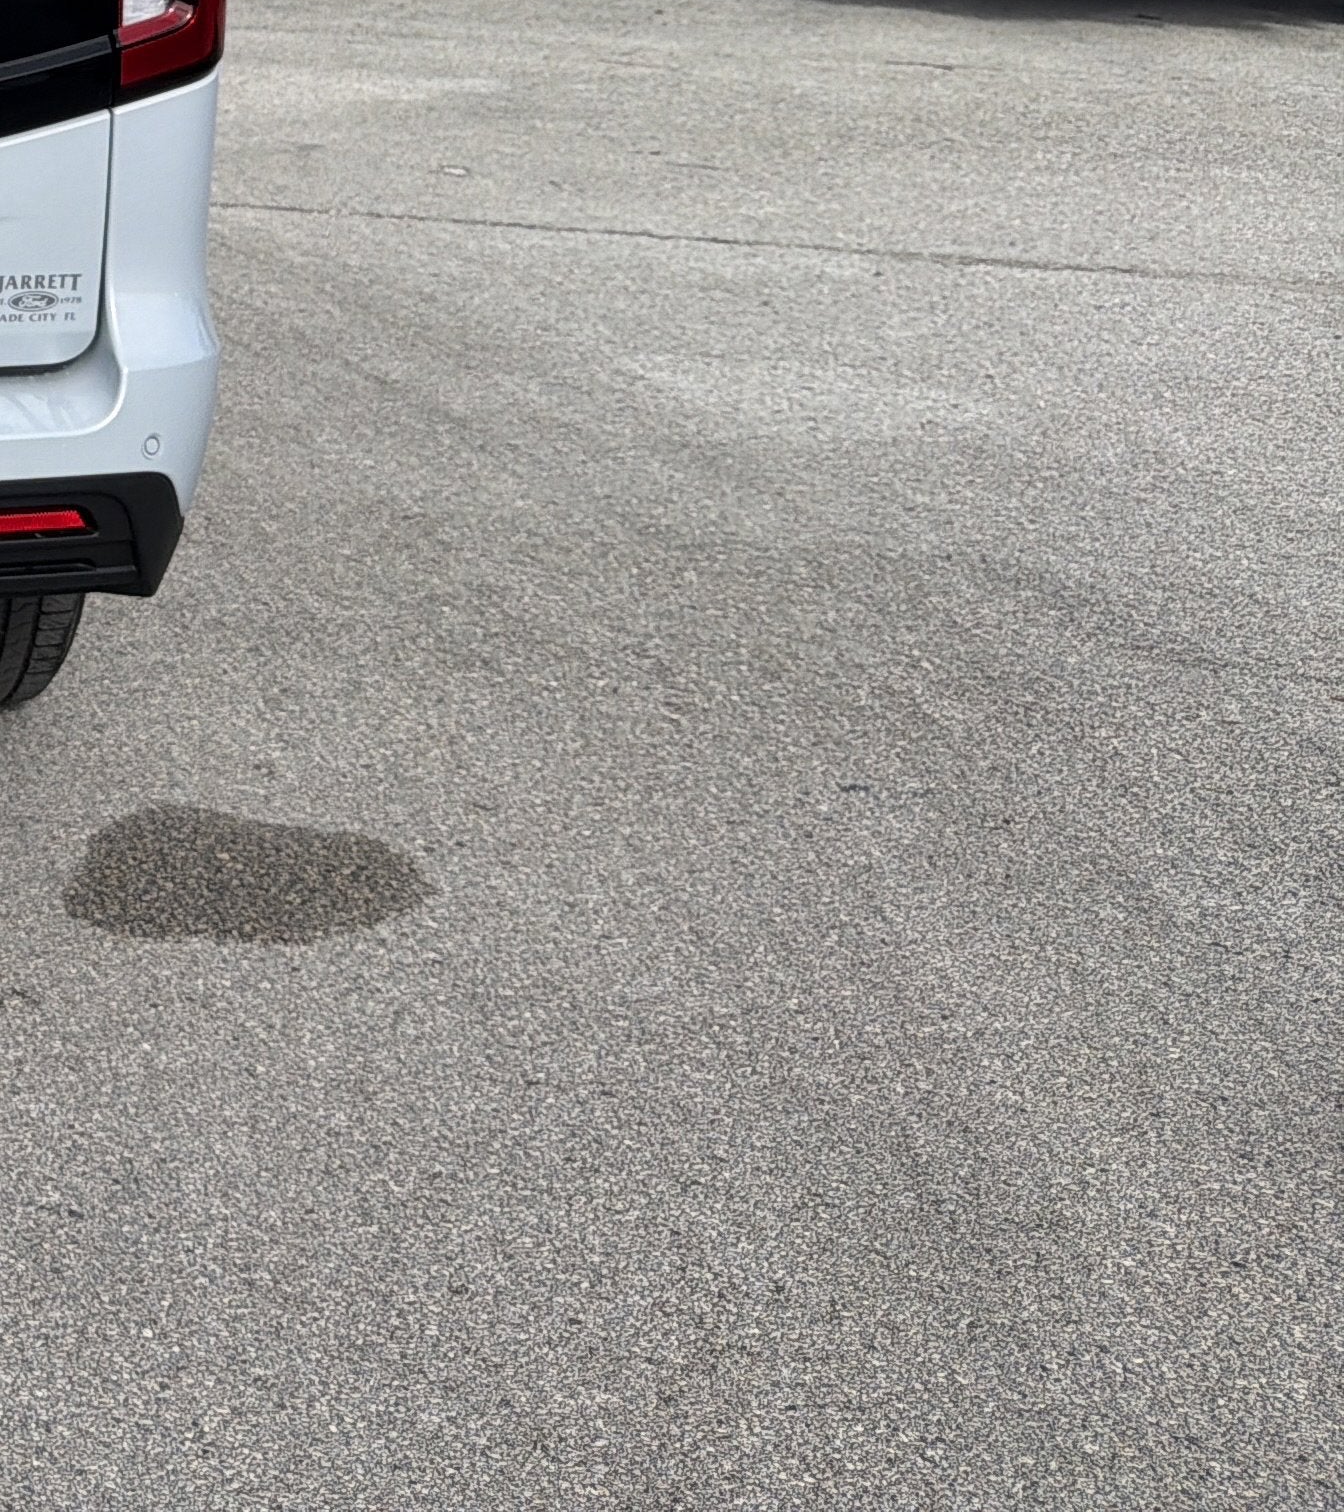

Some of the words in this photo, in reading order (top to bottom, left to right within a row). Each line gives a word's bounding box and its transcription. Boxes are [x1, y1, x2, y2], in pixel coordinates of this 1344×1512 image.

[60, 296, 83, 305] 1978
[28, 312, 57, 322] CITY
[64, 312, 76, 321] FL
